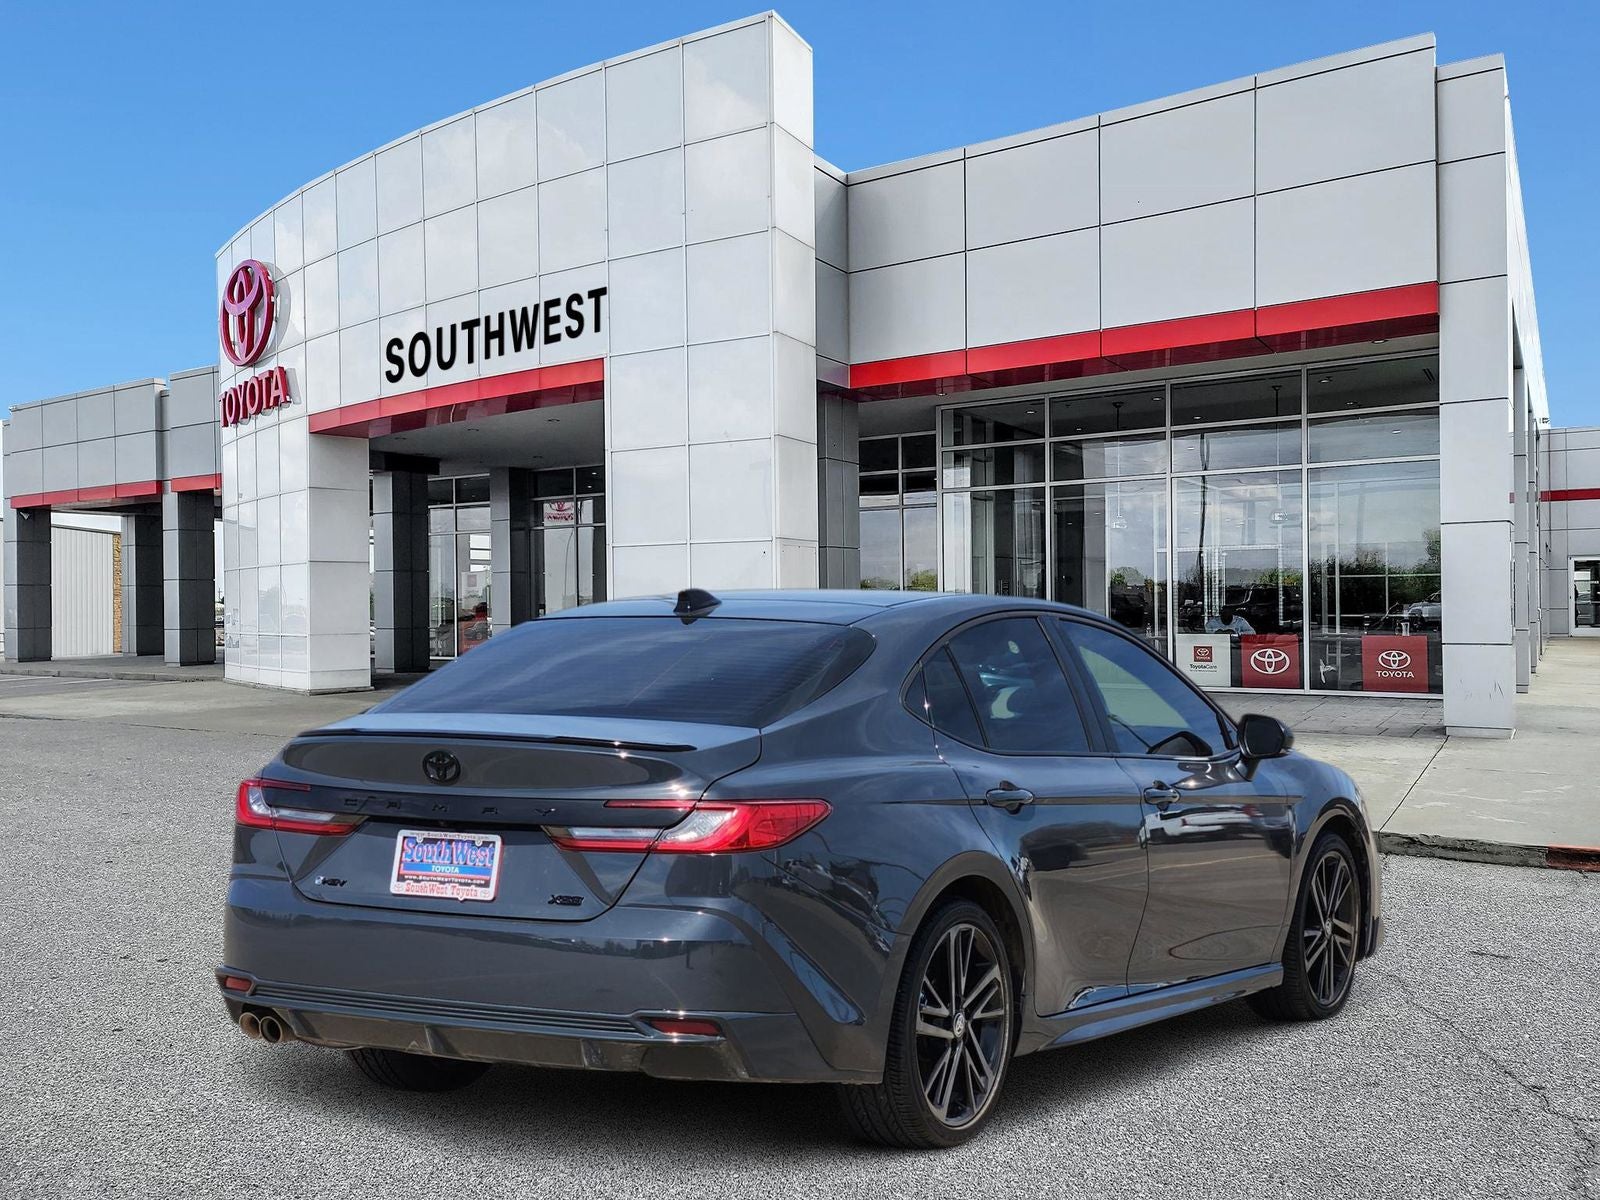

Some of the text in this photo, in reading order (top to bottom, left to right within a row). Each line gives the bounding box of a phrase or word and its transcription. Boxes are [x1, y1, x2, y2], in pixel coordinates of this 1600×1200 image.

[385, 286, 608, 384] SOUTHWEST
[218, 366, 292, 428] TOYOTA
[1375, 670, 1415, 678] TOYOTA
[402, 837, 496, 867] SouthWest
[431, 865, 460, 874] TOYOTA
[405, 881, 479, 898] SouthWest Toyota
